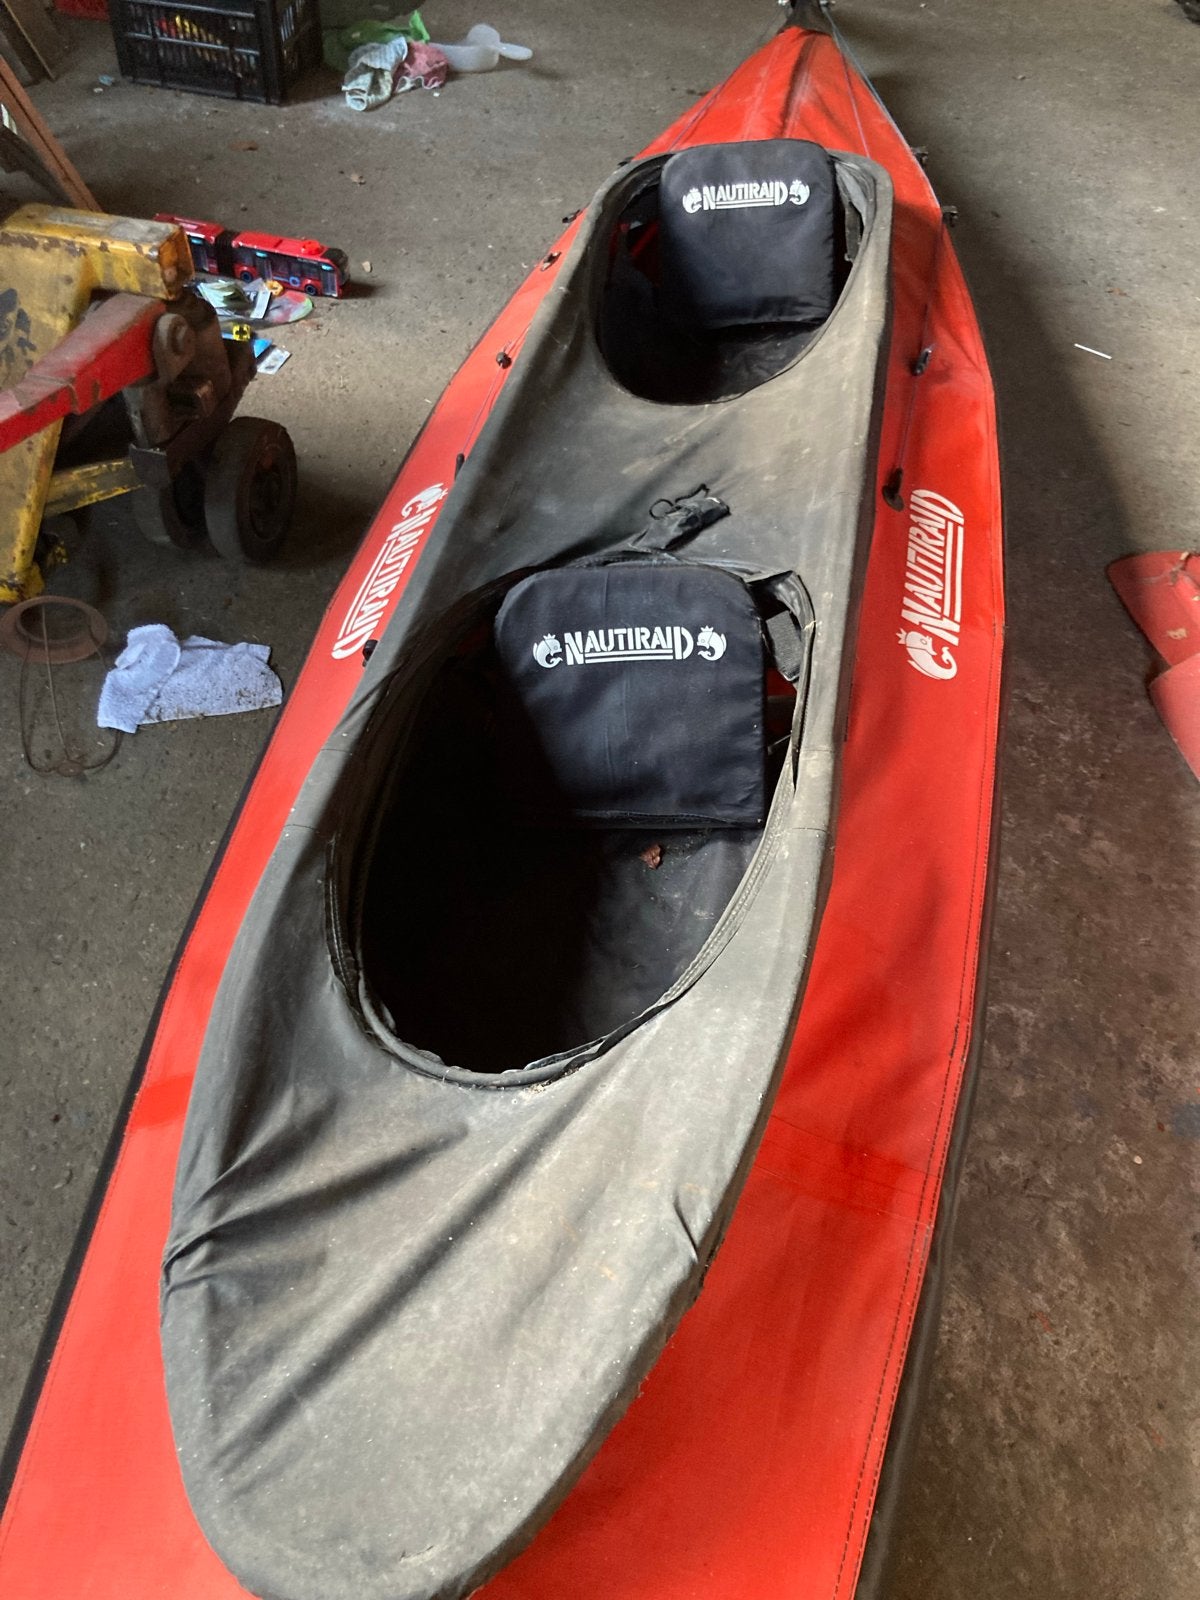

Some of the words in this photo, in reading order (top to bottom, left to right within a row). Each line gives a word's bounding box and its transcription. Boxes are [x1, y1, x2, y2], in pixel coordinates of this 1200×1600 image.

[702, 181, 789, 210] NAUTIRAID
[331, 506, 438, 660] NAUTIRAID
[901, 488, 965, 646] NAUTIRAID
[563, 626, 694, 666] NAUTIRAID
